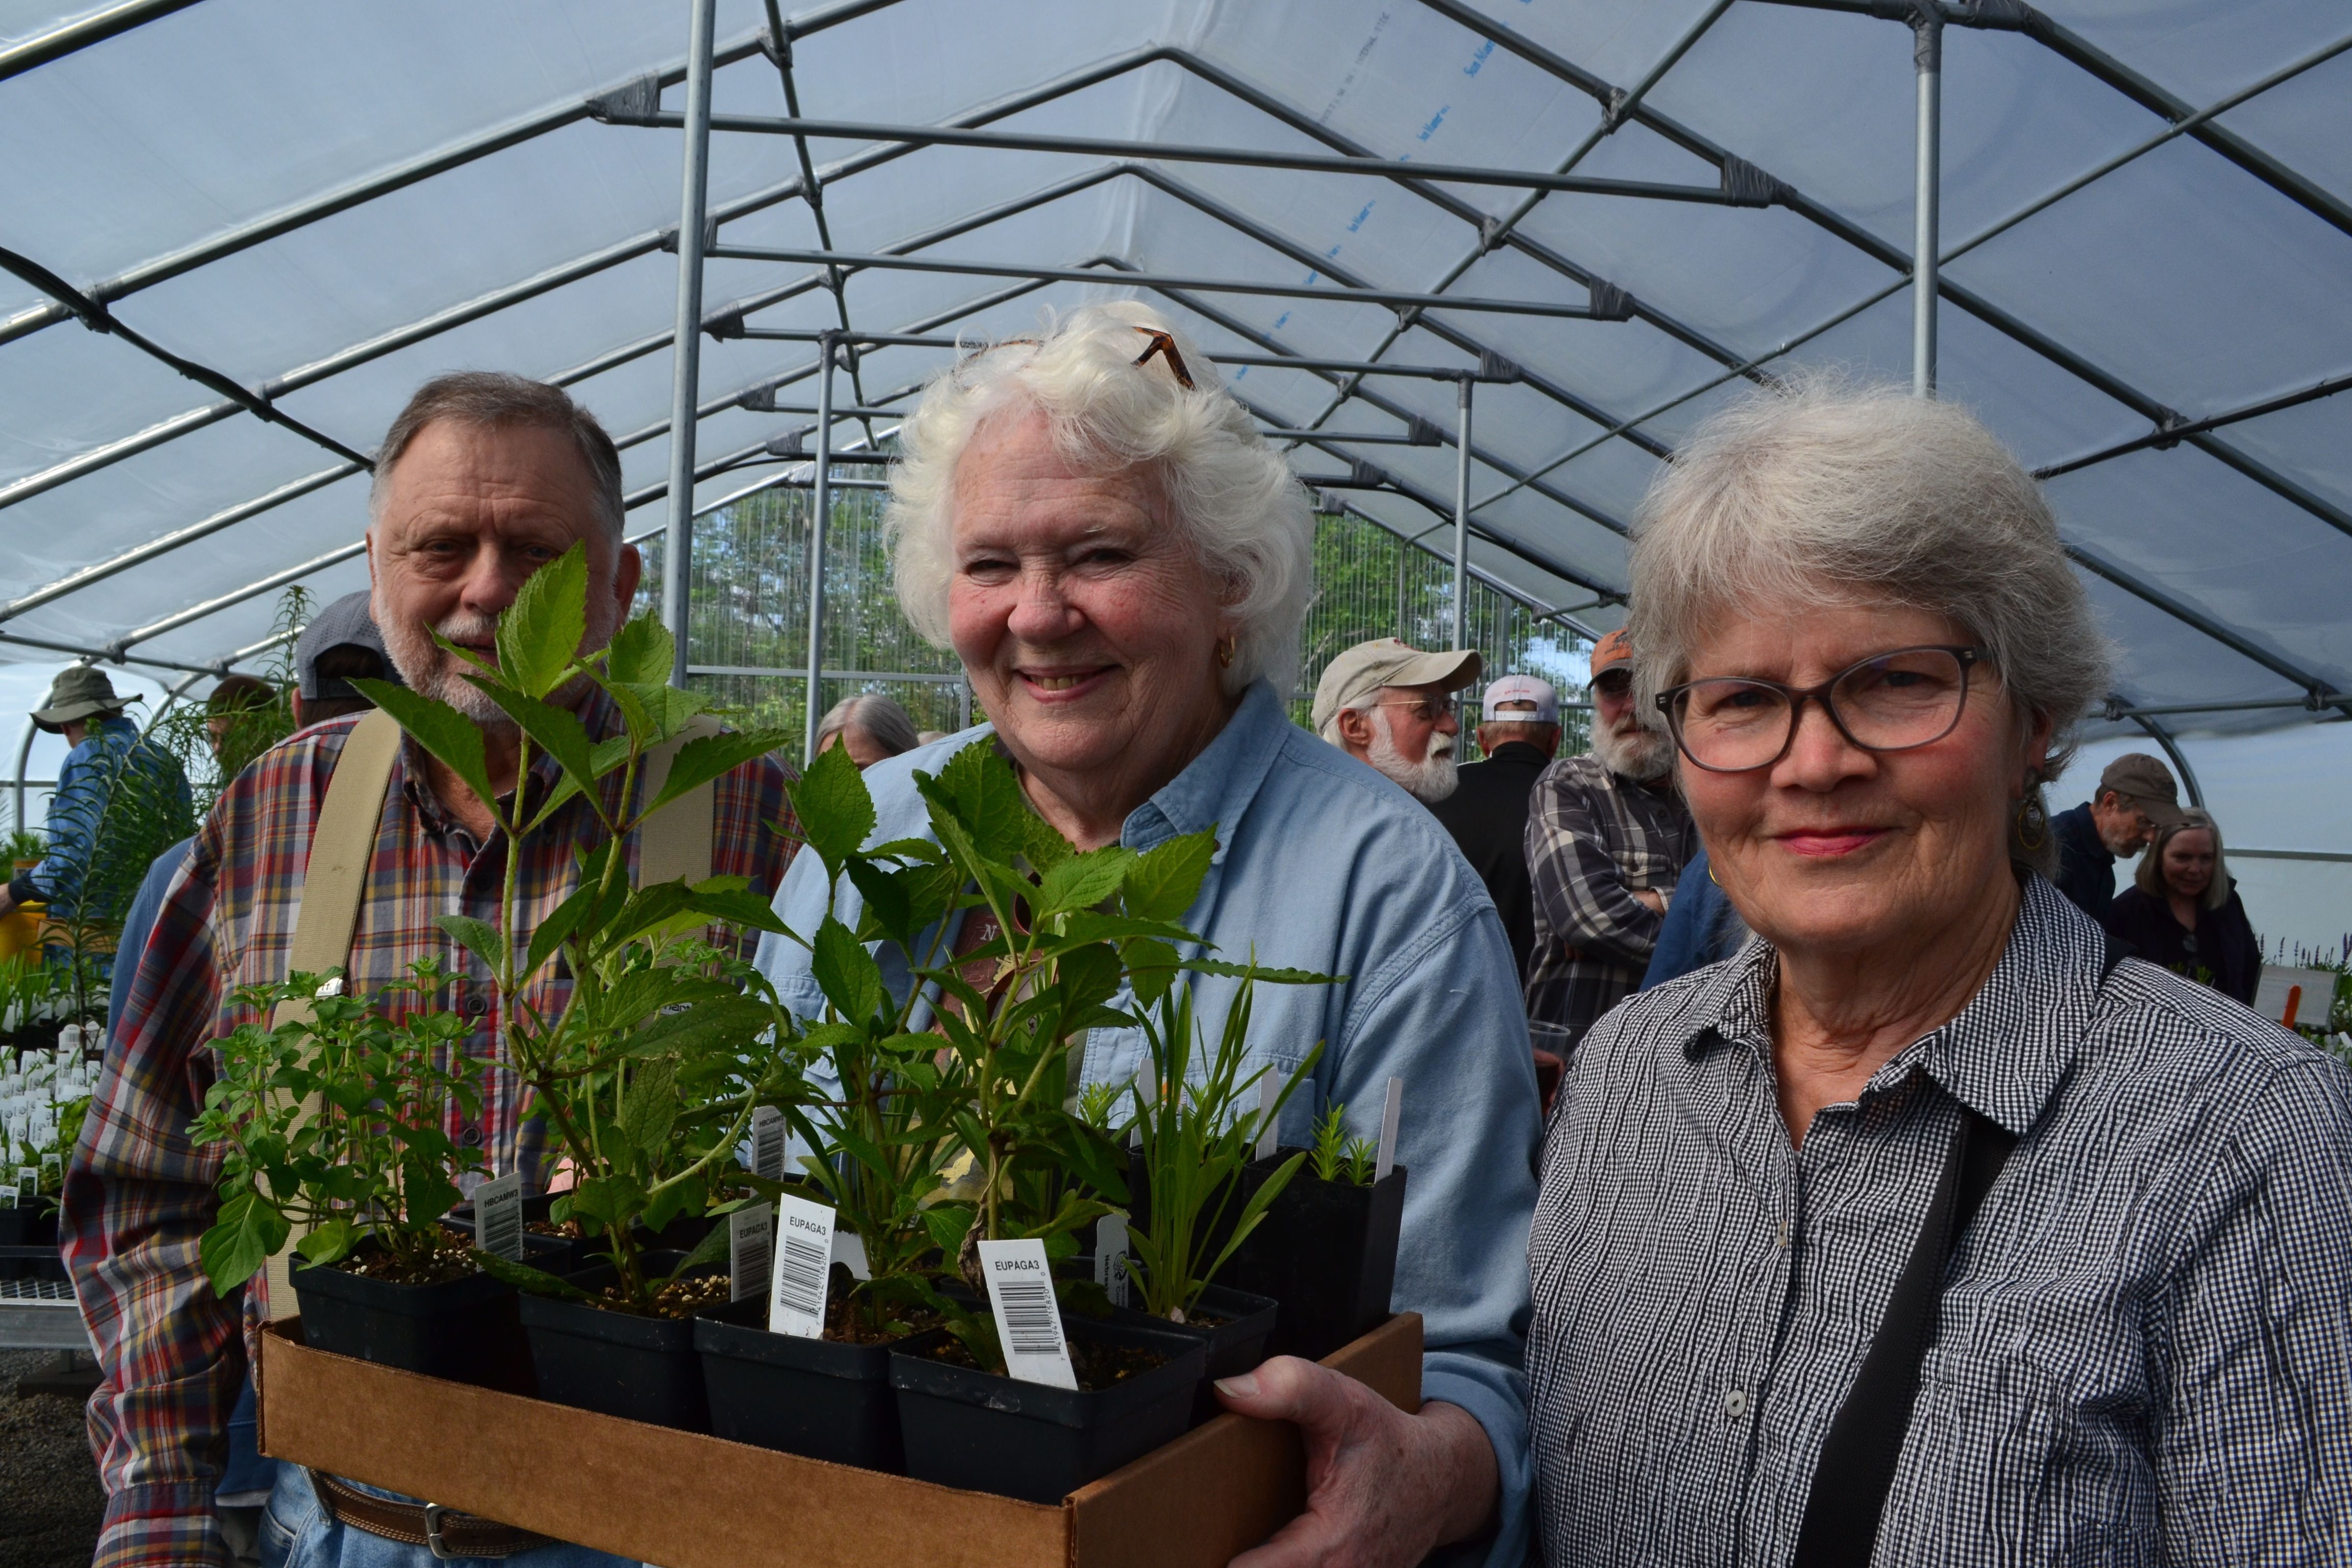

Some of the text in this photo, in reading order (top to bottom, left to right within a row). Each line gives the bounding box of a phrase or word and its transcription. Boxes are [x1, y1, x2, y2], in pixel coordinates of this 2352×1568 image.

[759, 1115, 784, 1128] HBCAMW3
[484, 1189, 519, 1208] HBCAMW3
[740, 1222, 768, 1239] EUPAGA3
[790, 1216, 826, 1236] EUPAGA3
[995, 1260, 1040, 1271] EUPAGA3
[1043, 1289, 1054, 1316] 15820
